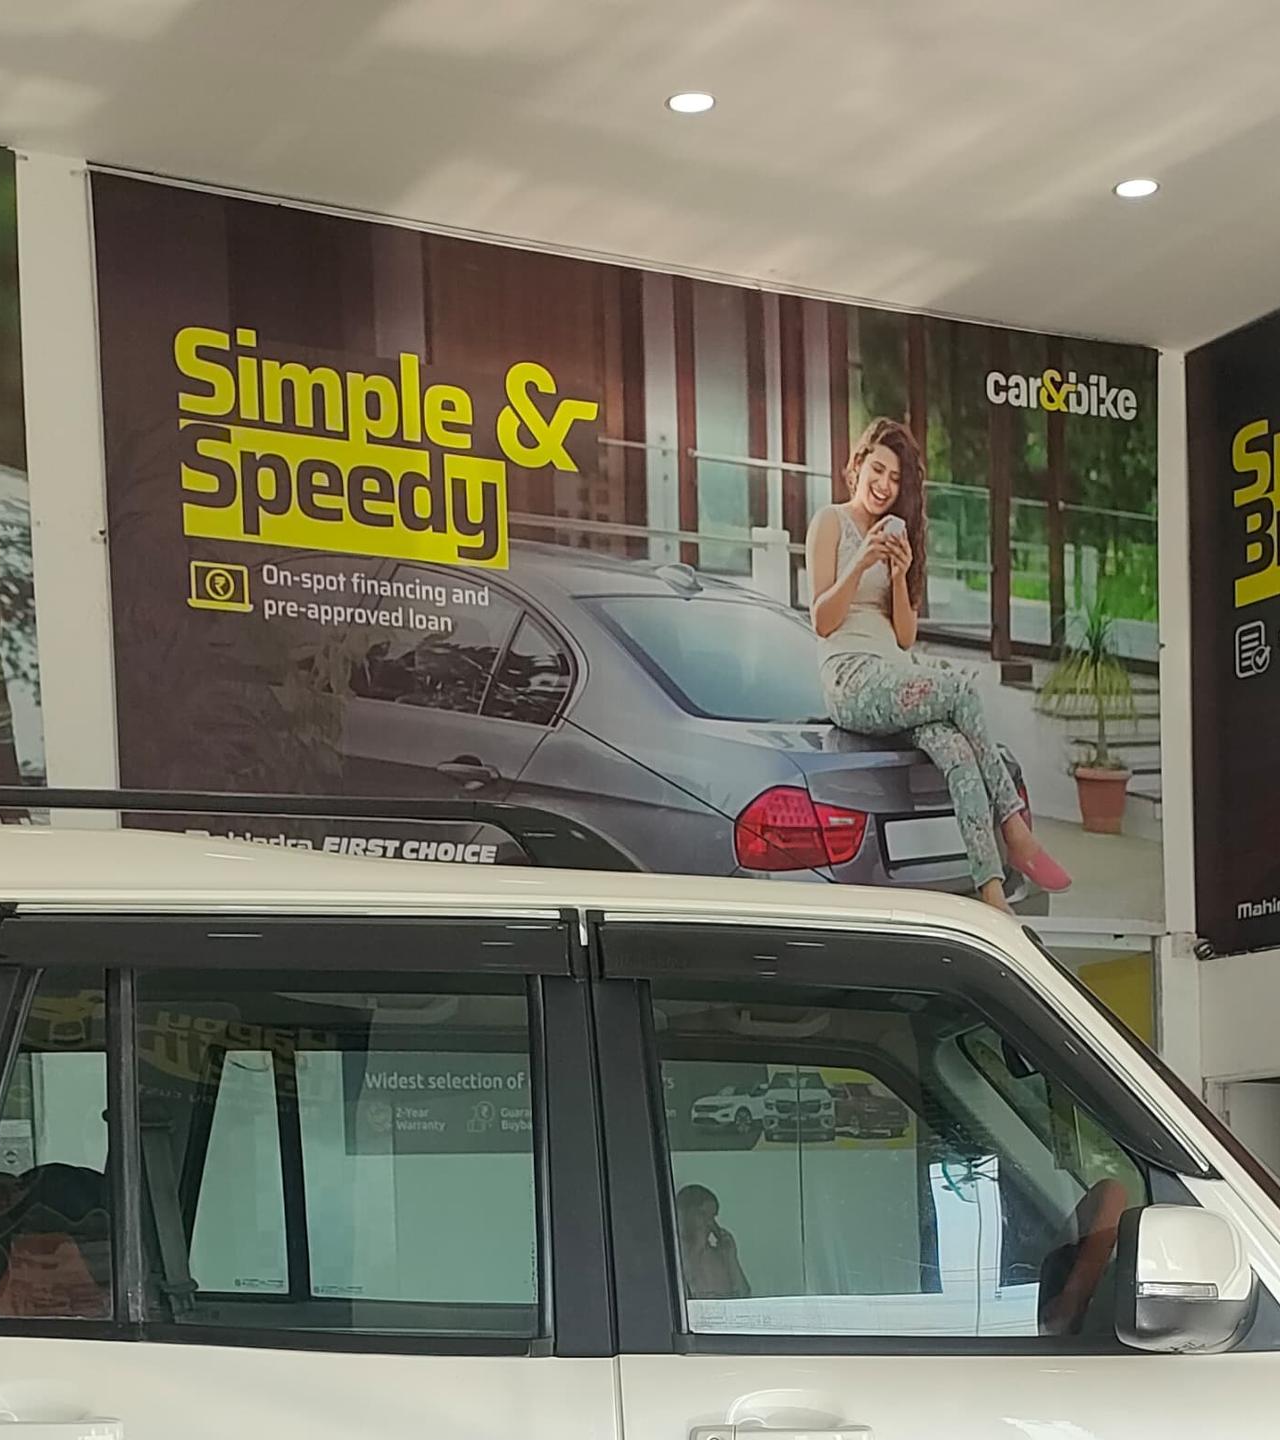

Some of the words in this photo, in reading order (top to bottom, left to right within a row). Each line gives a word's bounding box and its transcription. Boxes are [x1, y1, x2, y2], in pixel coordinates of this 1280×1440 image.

[174, 326, 474, 450] Simple
[496, 361, 599, 473] &
[986, 368, 1138, 421] car&bike
[180, 422, 500, 561] Speedy
[261, 564, 347, 593] On-spot
[351, 571, 446, 607] financing
[452, 586, 489, 606] and
[263, 598, 404, 627] pre-approved
[409, 608, 453, 632] loan
[322, 836, 400, 858] FIRST
[402, 840, 498, 865] CHOICE
[365, 1071, 427, 1090] Widest
[428, 1072, 503, 1090] selection
[506, 1071, 525, 1090] of
[396, 1107, 430, 1118] 2-Year
[396, 1120, 446, 1132] Warranty
